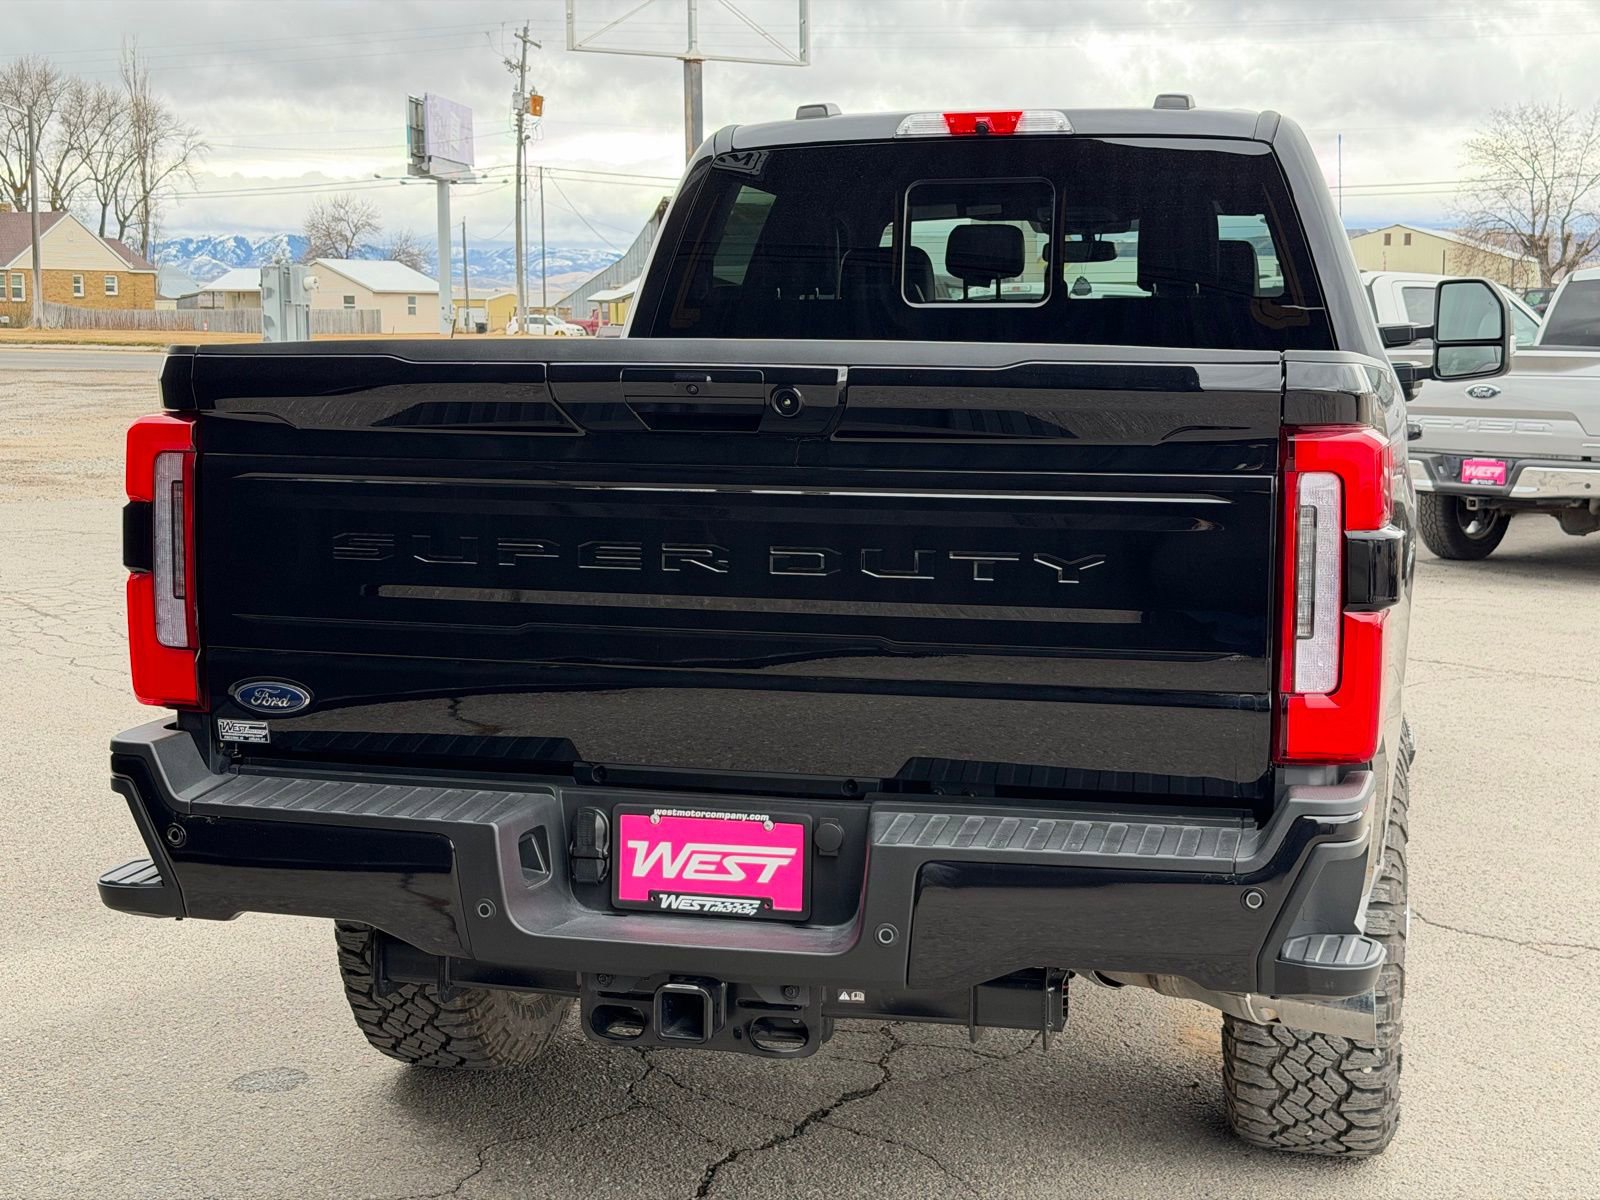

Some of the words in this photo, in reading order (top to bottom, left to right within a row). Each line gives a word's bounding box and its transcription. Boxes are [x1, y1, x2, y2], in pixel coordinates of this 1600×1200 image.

[1464, 465, 1504, 478] WEST
[333, 532, 729, 573] SUPER
[769, 545, 1106, 584] DUTY
[251, 687, 292, 707] Ford
[653, 808, 770, 822] westmotorcompany.com
[627, 839, 798, 884] WEST
